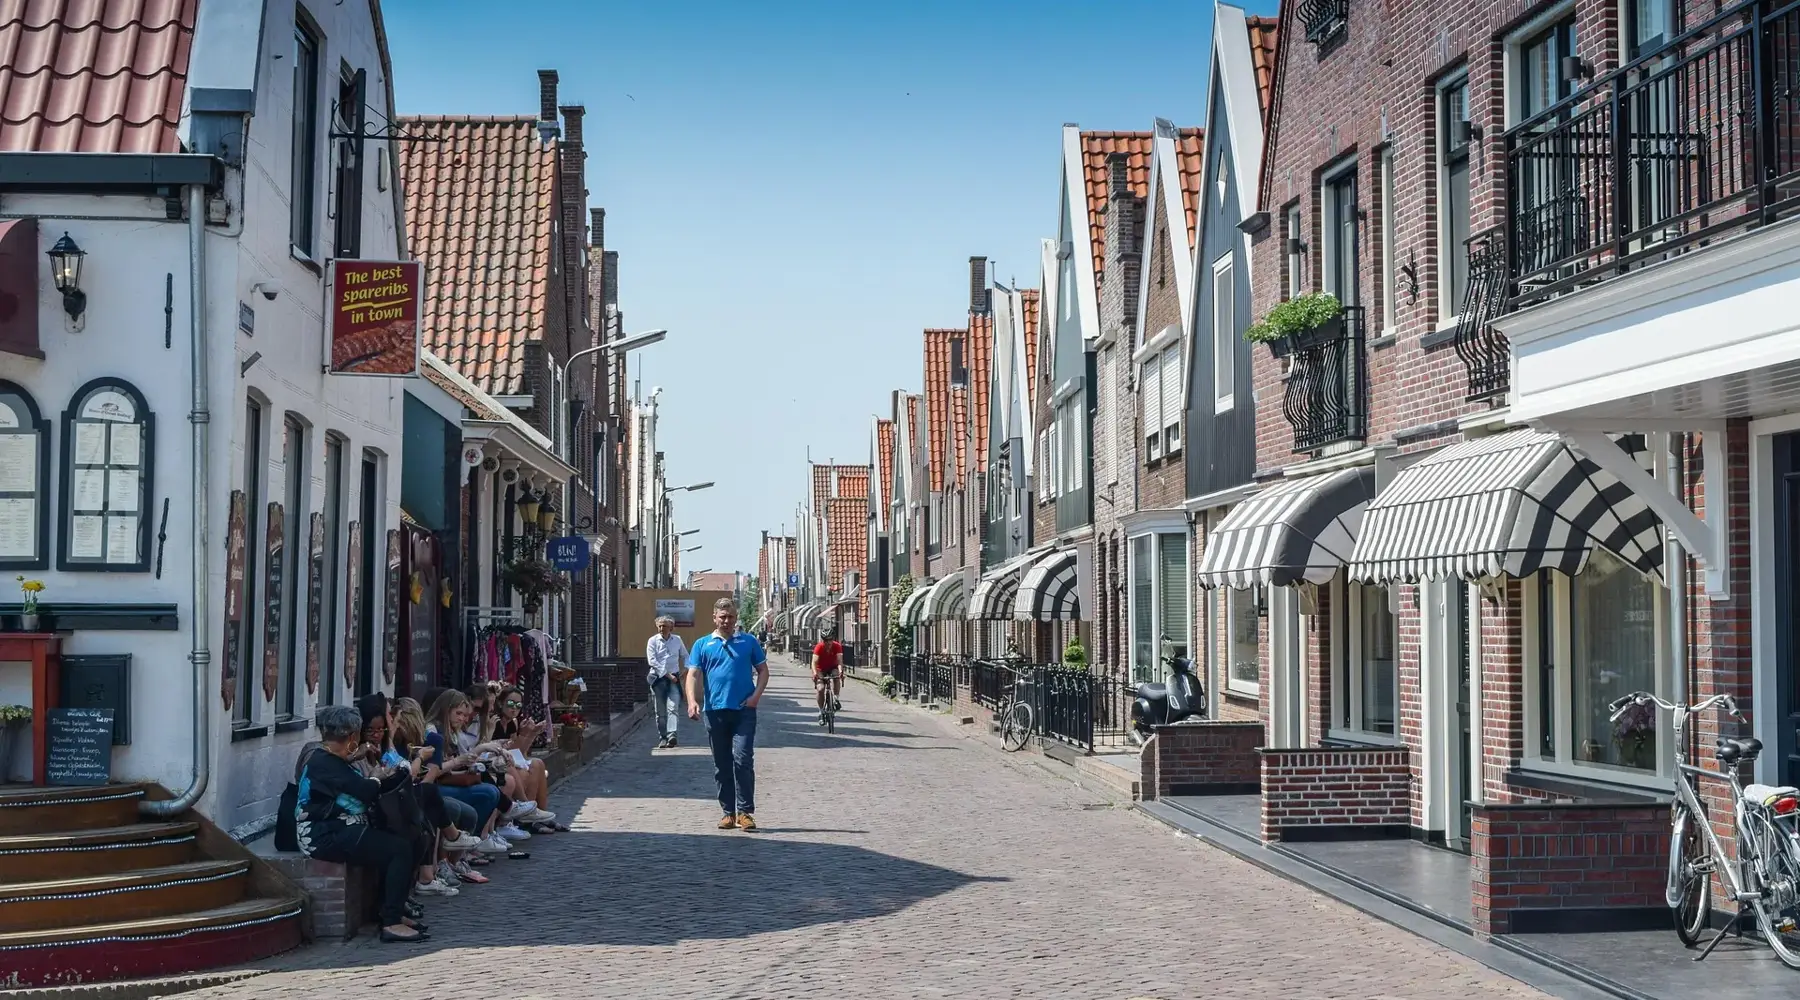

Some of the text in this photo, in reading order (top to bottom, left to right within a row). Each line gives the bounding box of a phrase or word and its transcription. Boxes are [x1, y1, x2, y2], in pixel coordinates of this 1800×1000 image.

[345, 266, 402, 285] The best
[343, 283, 408, 302] spareribs
[351, 307, 403, 324] in town
